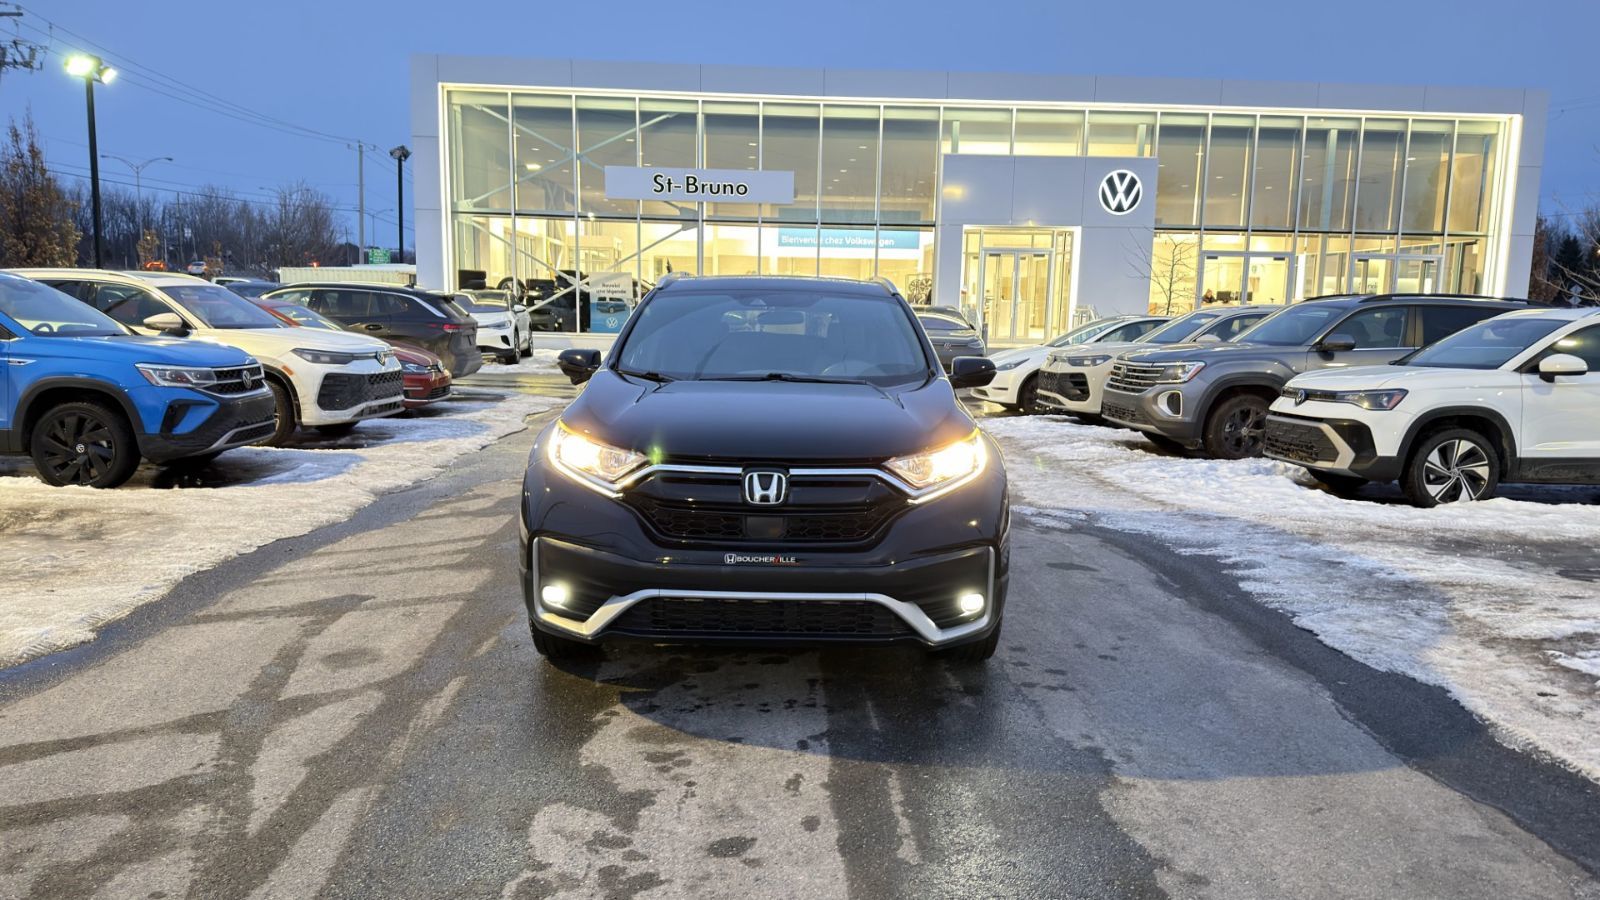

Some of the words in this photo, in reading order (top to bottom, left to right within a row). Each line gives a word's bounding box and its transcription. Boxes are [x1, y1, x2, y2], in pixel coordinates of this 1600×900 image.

[653, 174, 748, 195] St-Bruno
[825, 237, 843, 245] chez
[736, 554, 796, 563] BOUCHERVILLE
